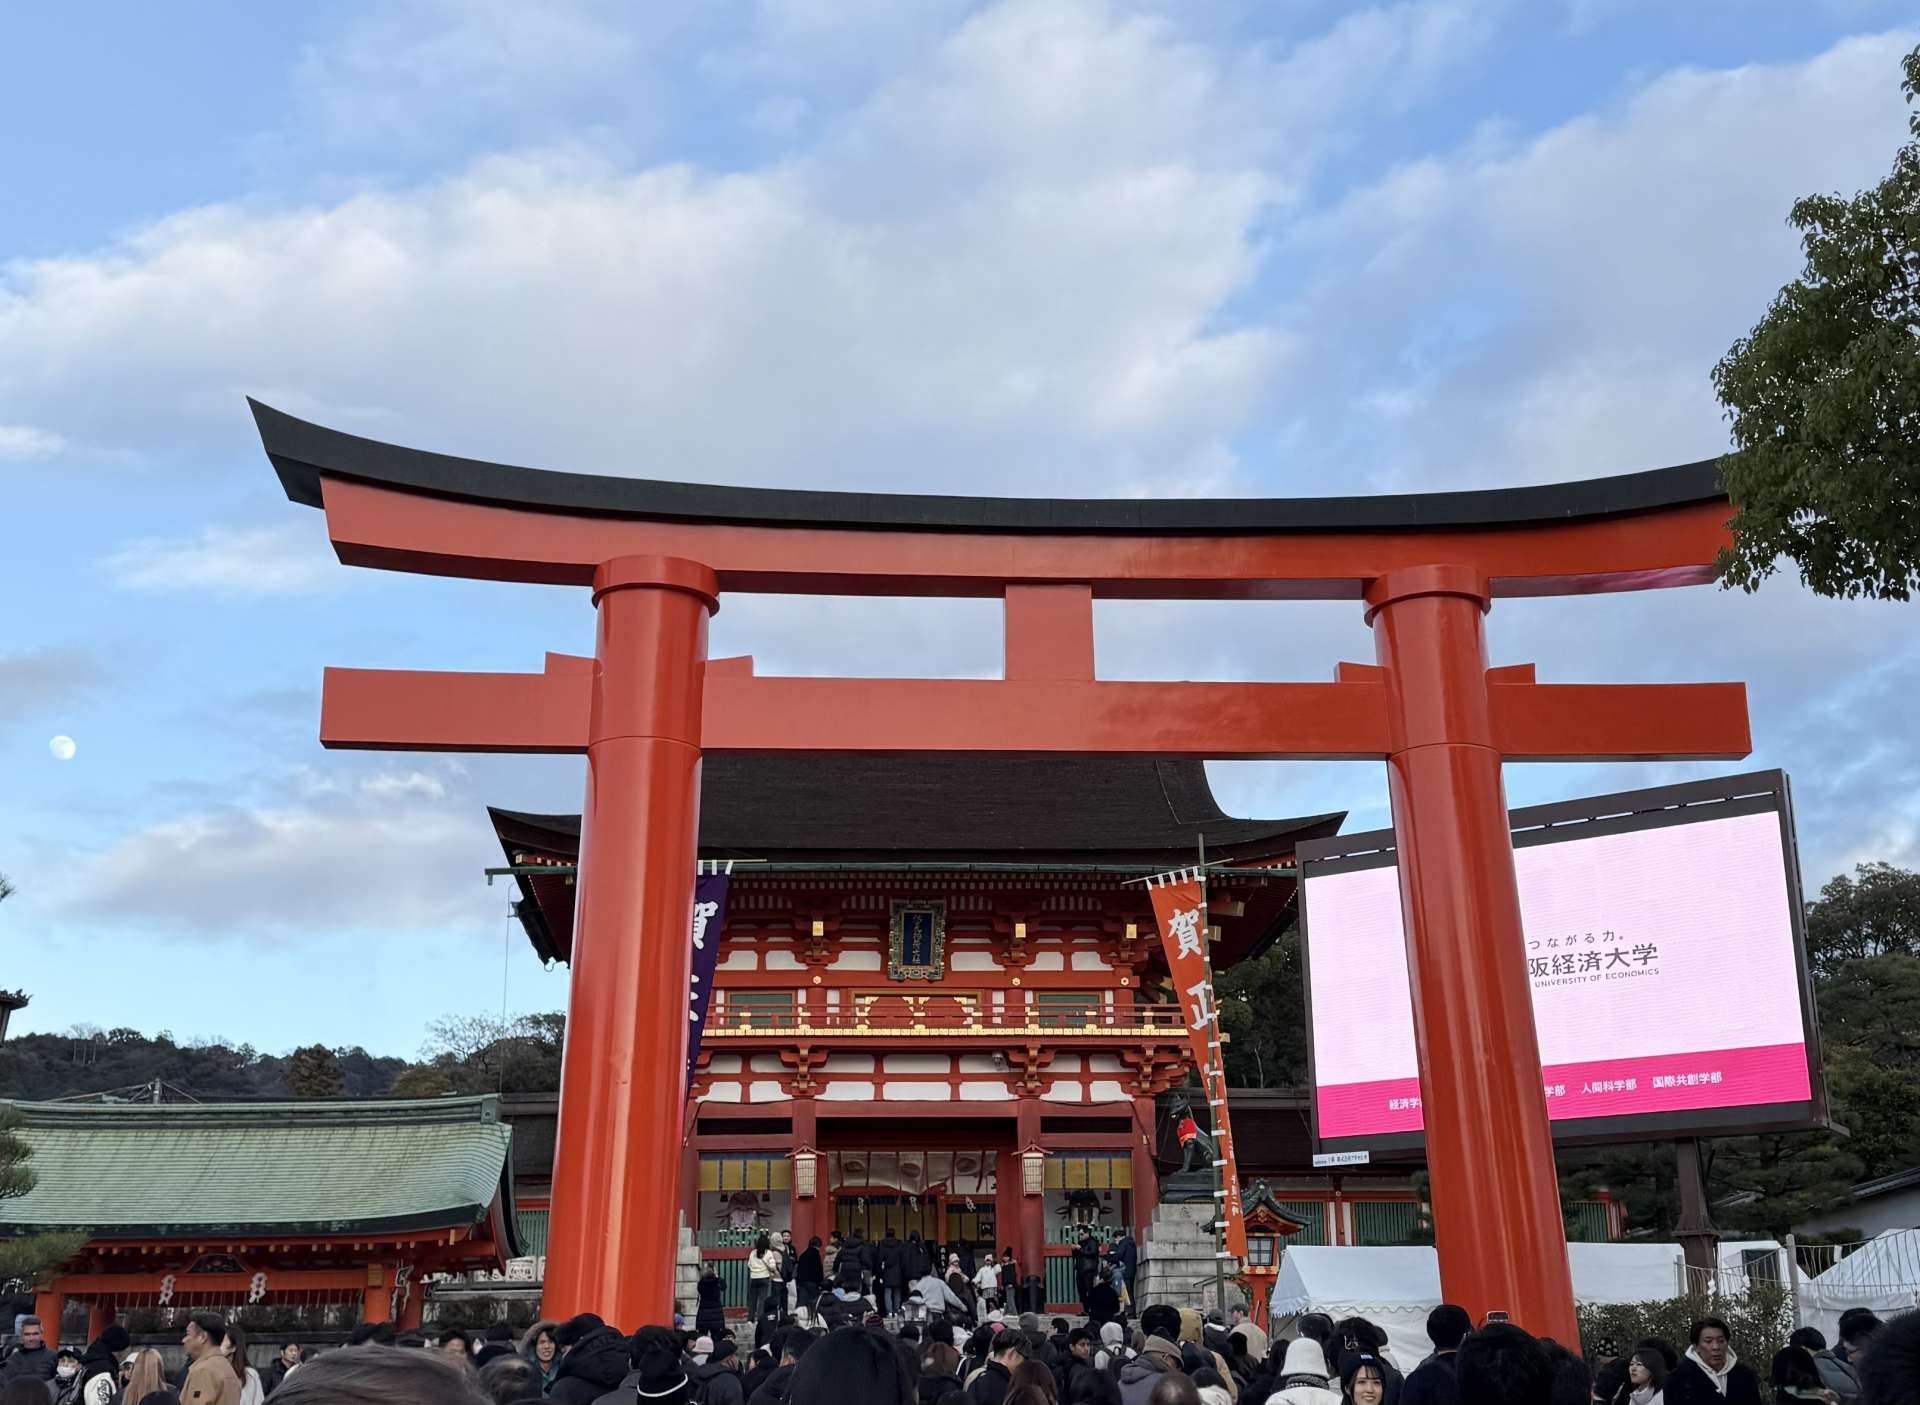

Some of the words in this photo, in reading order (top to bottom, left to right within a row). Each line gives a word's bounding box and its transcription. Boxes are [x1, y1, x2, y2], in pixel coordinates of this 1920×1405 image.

[1535, 976, 1587, 988] UNIVERSITY
[1590, 974, 1602, 982] OF
[1605, 968, 1660, 980] ECONOMICS
[1389, 1096, 1421, 1110] 経済学
[1581, 1078, 1638, 1094] 人間科学部
[1652, 1071, 1723, 1089] 国際共創学部
